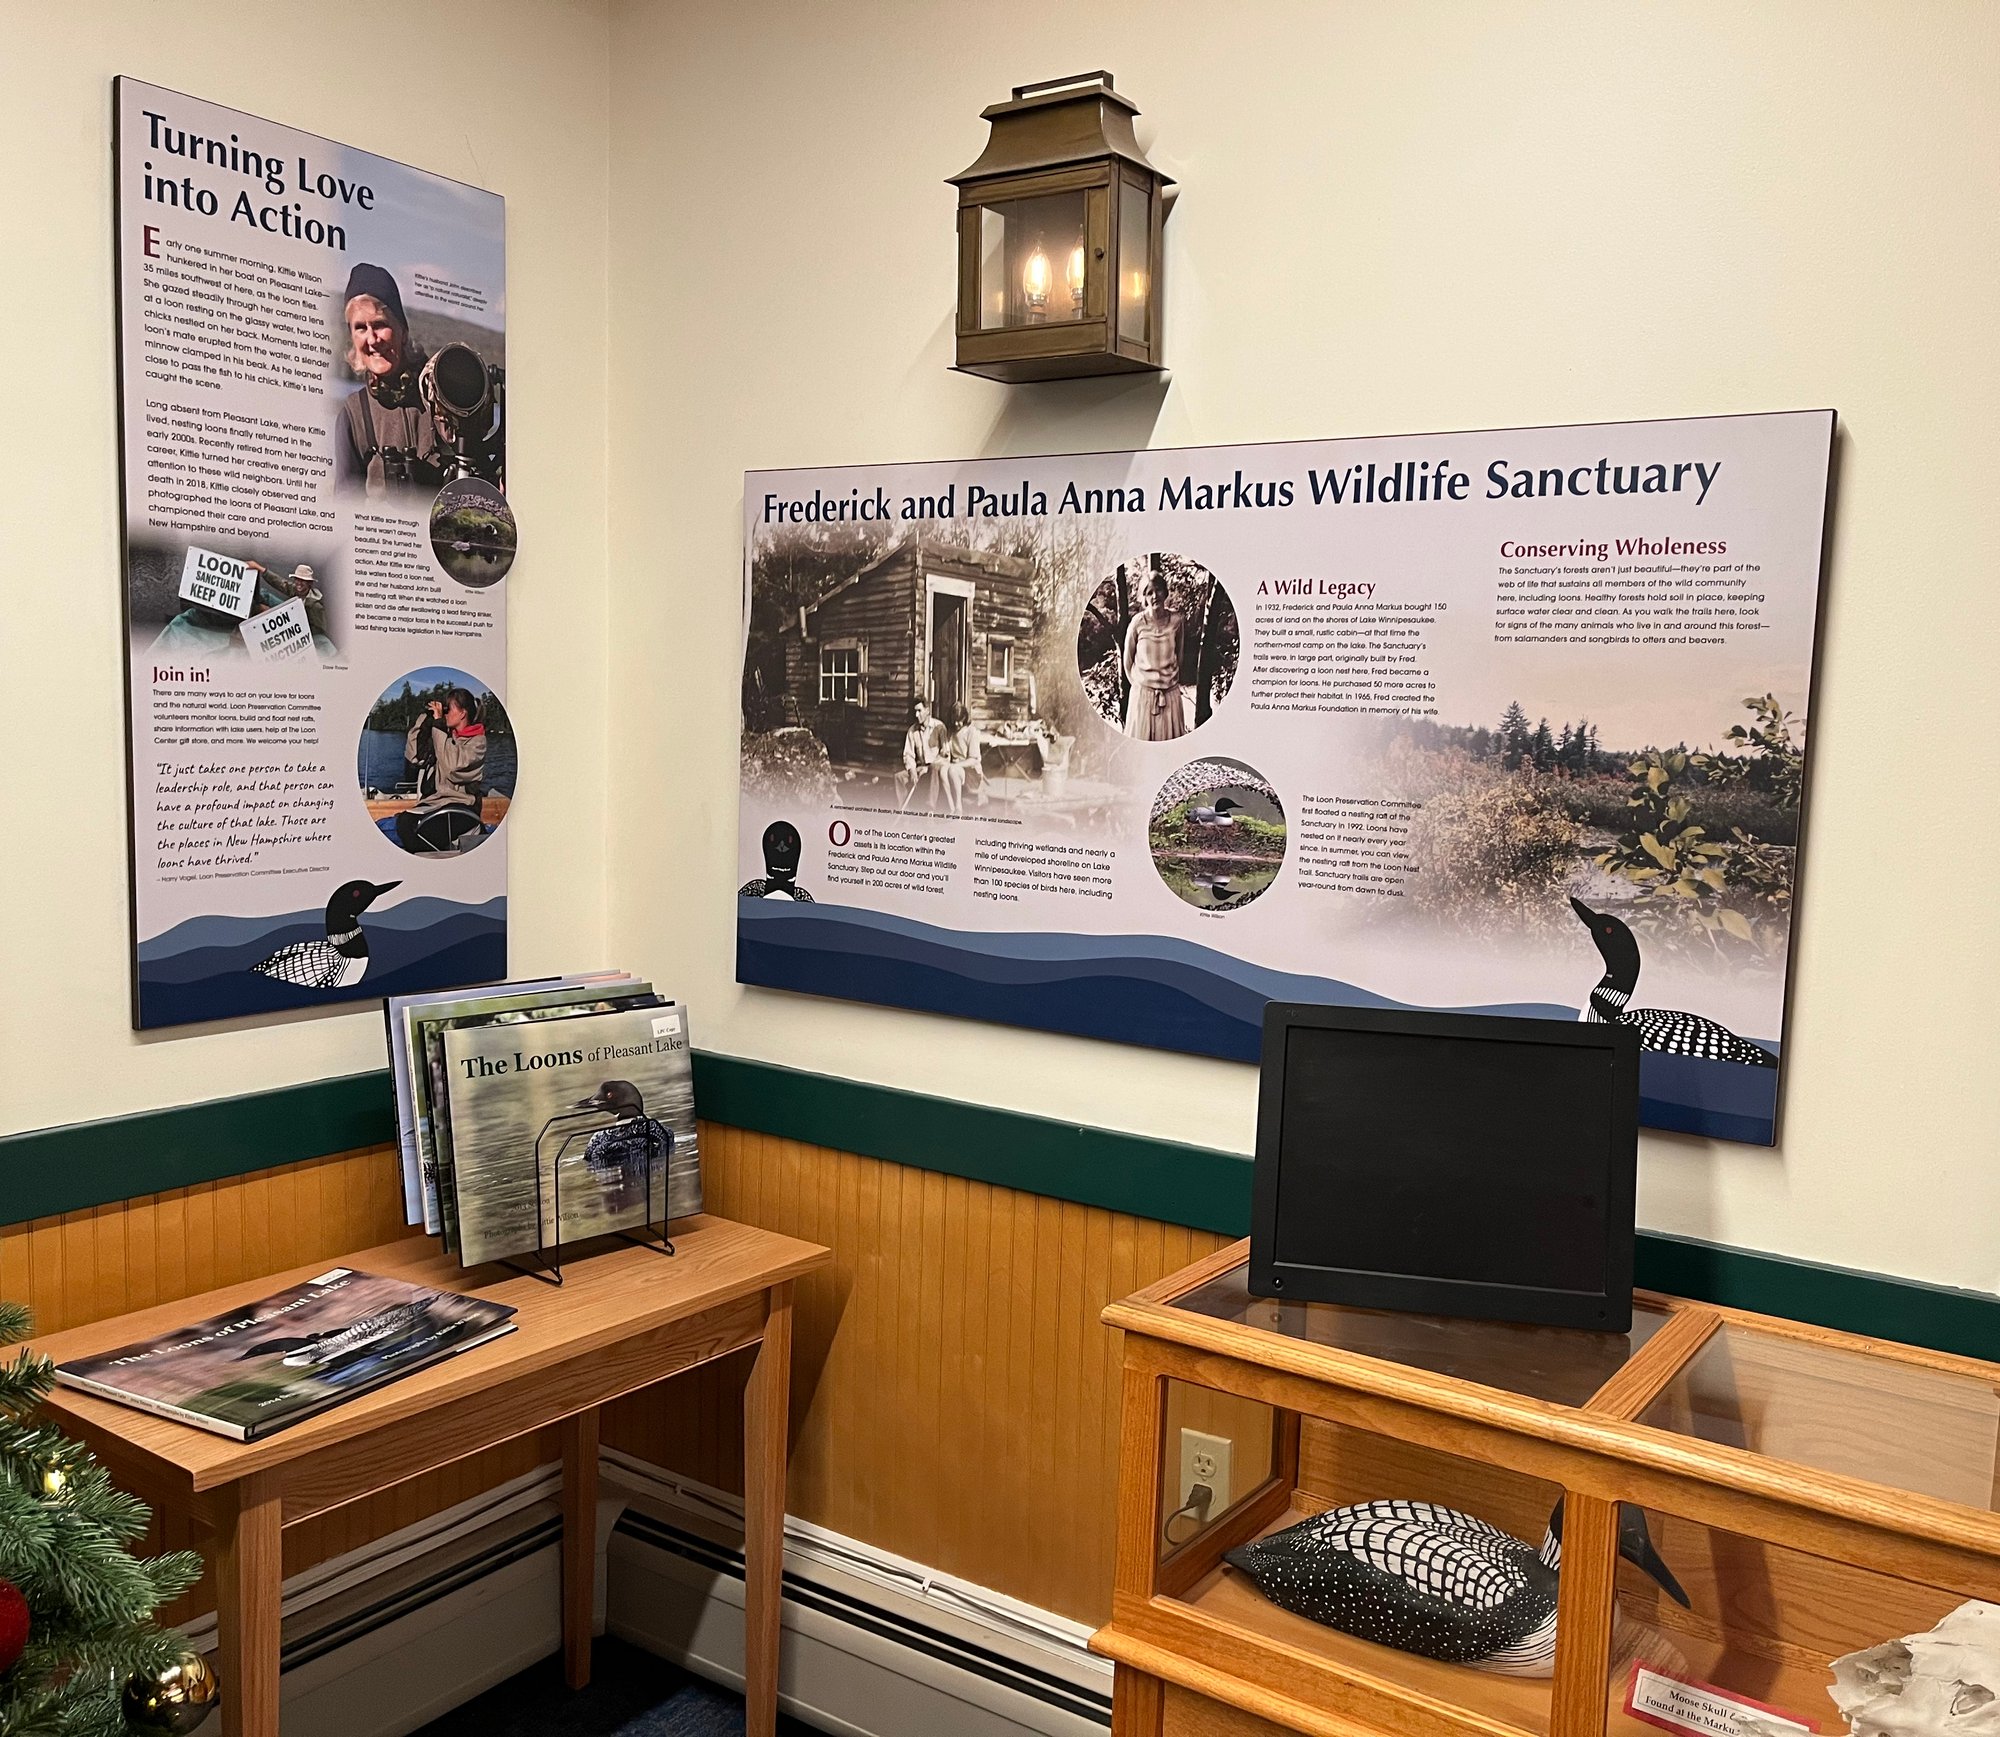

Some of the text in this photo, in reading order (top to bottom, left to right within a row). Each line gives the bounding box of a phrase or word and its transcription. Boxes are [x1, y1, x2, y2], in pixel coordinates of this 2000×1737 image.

[142, 110, 374, 210] Turning Love
[144, 161, 346, 251] into Action
[166, 253, 207, 270] hunkered
[209, 263, 217, 272] in
[219, 266, 233, 276] her
[235, 269, 255, 281] boat
[256, 276, 267, 284] on
[269, 278, 303, 293] Pleasant
[184, 244, 202, 254] one
[203, 249, 237, 263] summer
[239, 258, 276, 273] morning,
[277, 266, 296, 277] Kittie
[297, 271, 322, 283] Wilson
[764, 457, 1721, 523] Frederick and Paula Anna Markus Wildlife Sanctuary
[149, 518, 168, 527] New
[170, 520, 216, 533] Hampshire
[218, 527, 235, 535] and
[354, 513, 370, 521] What
[370, 515, 384, 523] Kittie
[397, 519, 419, 528] through
[1500, 537, 1726, 562] Conserving Wholeness
[198, 553, 244, 580] LOON
[1563, 566, 1589, 574] forests
[1617, 566, 1632, 575] just
[1713, 564, 1732, 573] part
[1734, 564, 1744, 572] of
[196, 570, 241, 593] SANCTUARY
[1257, 578, 1376, 600] A Wild Legacy
[190, 582, 241, 611] KEEP OUT
[1282, 603, 1314, 611] Frederick
[1404, 603, 1432, 612] bought
[1434, 602, 1447, 610] 150
[262, 611, 291, 634] LOON
[260, 624, 302, 652] NESTING
[153, 666, 210, 683] Join in!
[172, 764, 195, 778] just
[198, 762, 226, 774] takes
[248, 765, 280, 776] person
[284, 763, 293, 772] to
[297, 761, 317, 773] take
[155, 781, 208, 796] leadership
[212, 780, 232, 792] role,
[236, 780, 257, 791] and
[259, 780, 281, 791] that
[283, 782, 314, 794] person
[156, 801, 181, 811] have
[194, 799, 240, 814] profound
[242, 799, 275, 813] impact
[292, 797, 334, 810] changing
[1302, 794, 1314, 802] The
[1335, 796, 1379, 806] Preservation
[1380, 799, 1422, 809] Committee
[157, 815, 326, 831] the culture of that lake. Those are
[157, 831, 331, 852] the places in New Hampshire where
[872, 829, 883, 837] The
[884, 830, 900, 838] Loon
[928, 836, 955, 844] greatest
[157, 857, 185, 868] loons
[187, 856, 212, 866] have
[973, 891, 998, 901] nesting
[460, 1038, 682, 1080] The Loons of Pleasant Lake
[108, 1279, 351, 1367] The Loons of Pleasant Lake
[1645, 1695, 1674, 1713] Found
[1676, 1707, 1685, 1717] at
[1687, 1709, 1701, 1722] the
[1669, 1690, 1700, 1708] Moose
[1702, 1702, 1727, 1718] Skull
